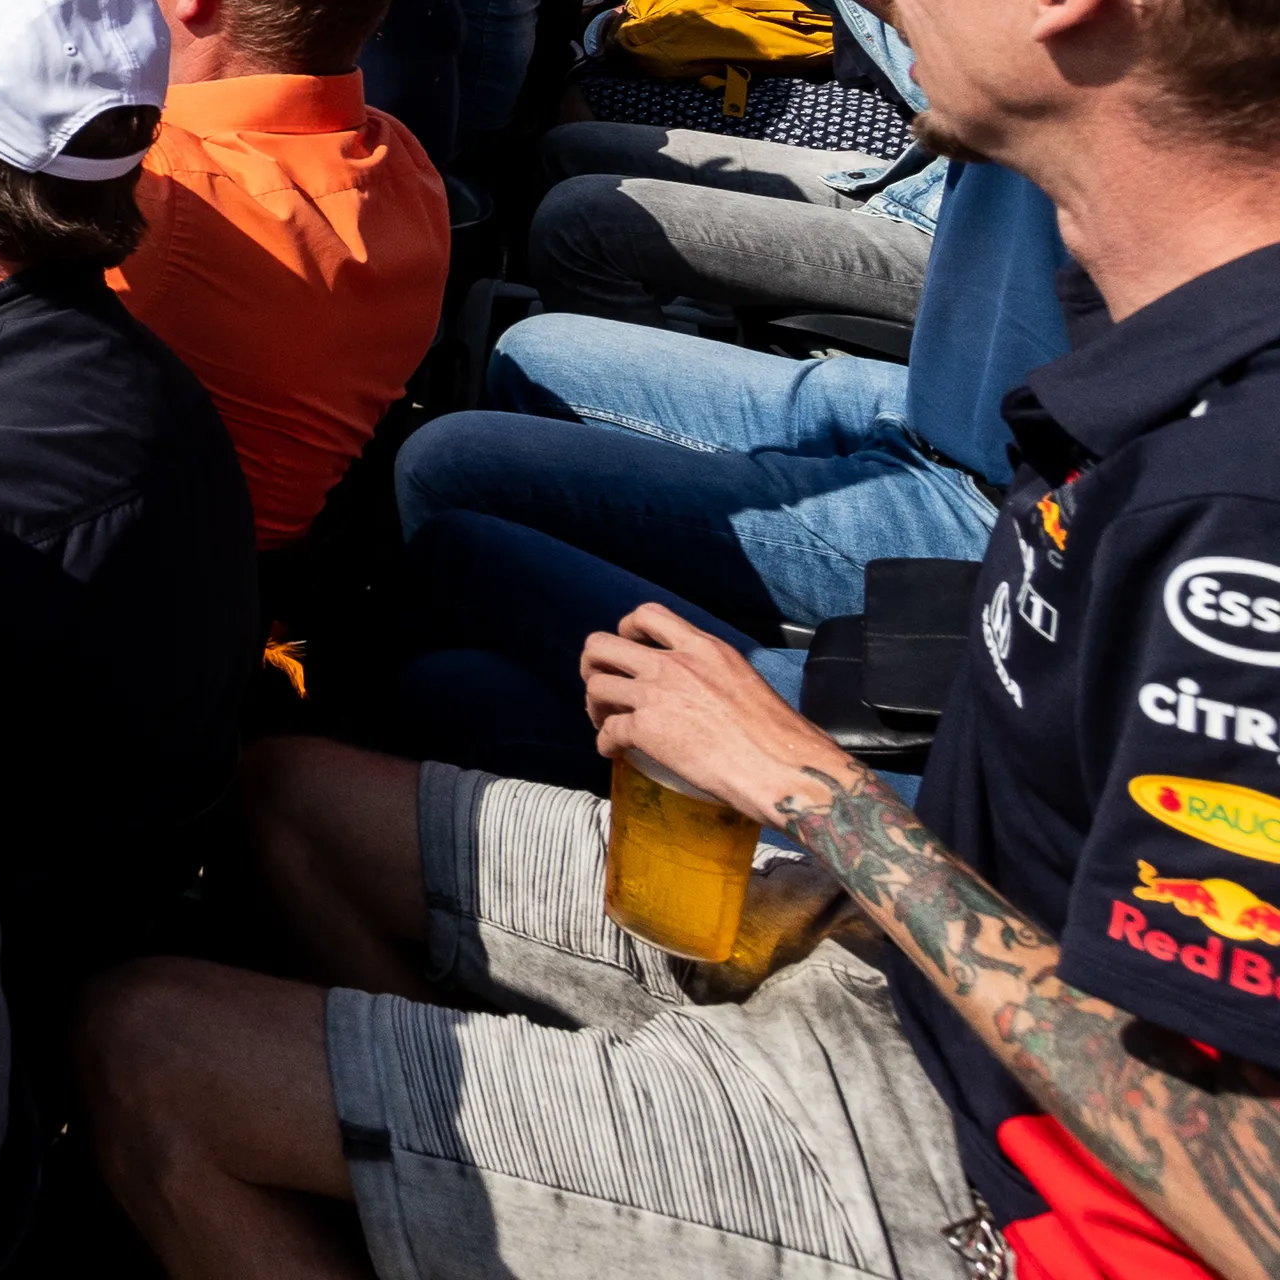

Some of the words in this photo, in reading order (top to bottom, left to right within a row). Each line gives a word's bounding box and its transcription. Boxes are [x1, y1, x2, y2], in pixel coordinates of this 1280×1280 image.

[1185, 576, 1280, 633] Ess
[1187, 795, 1280, 844] RAUC
[1106, 899, 1222, 981] Red
